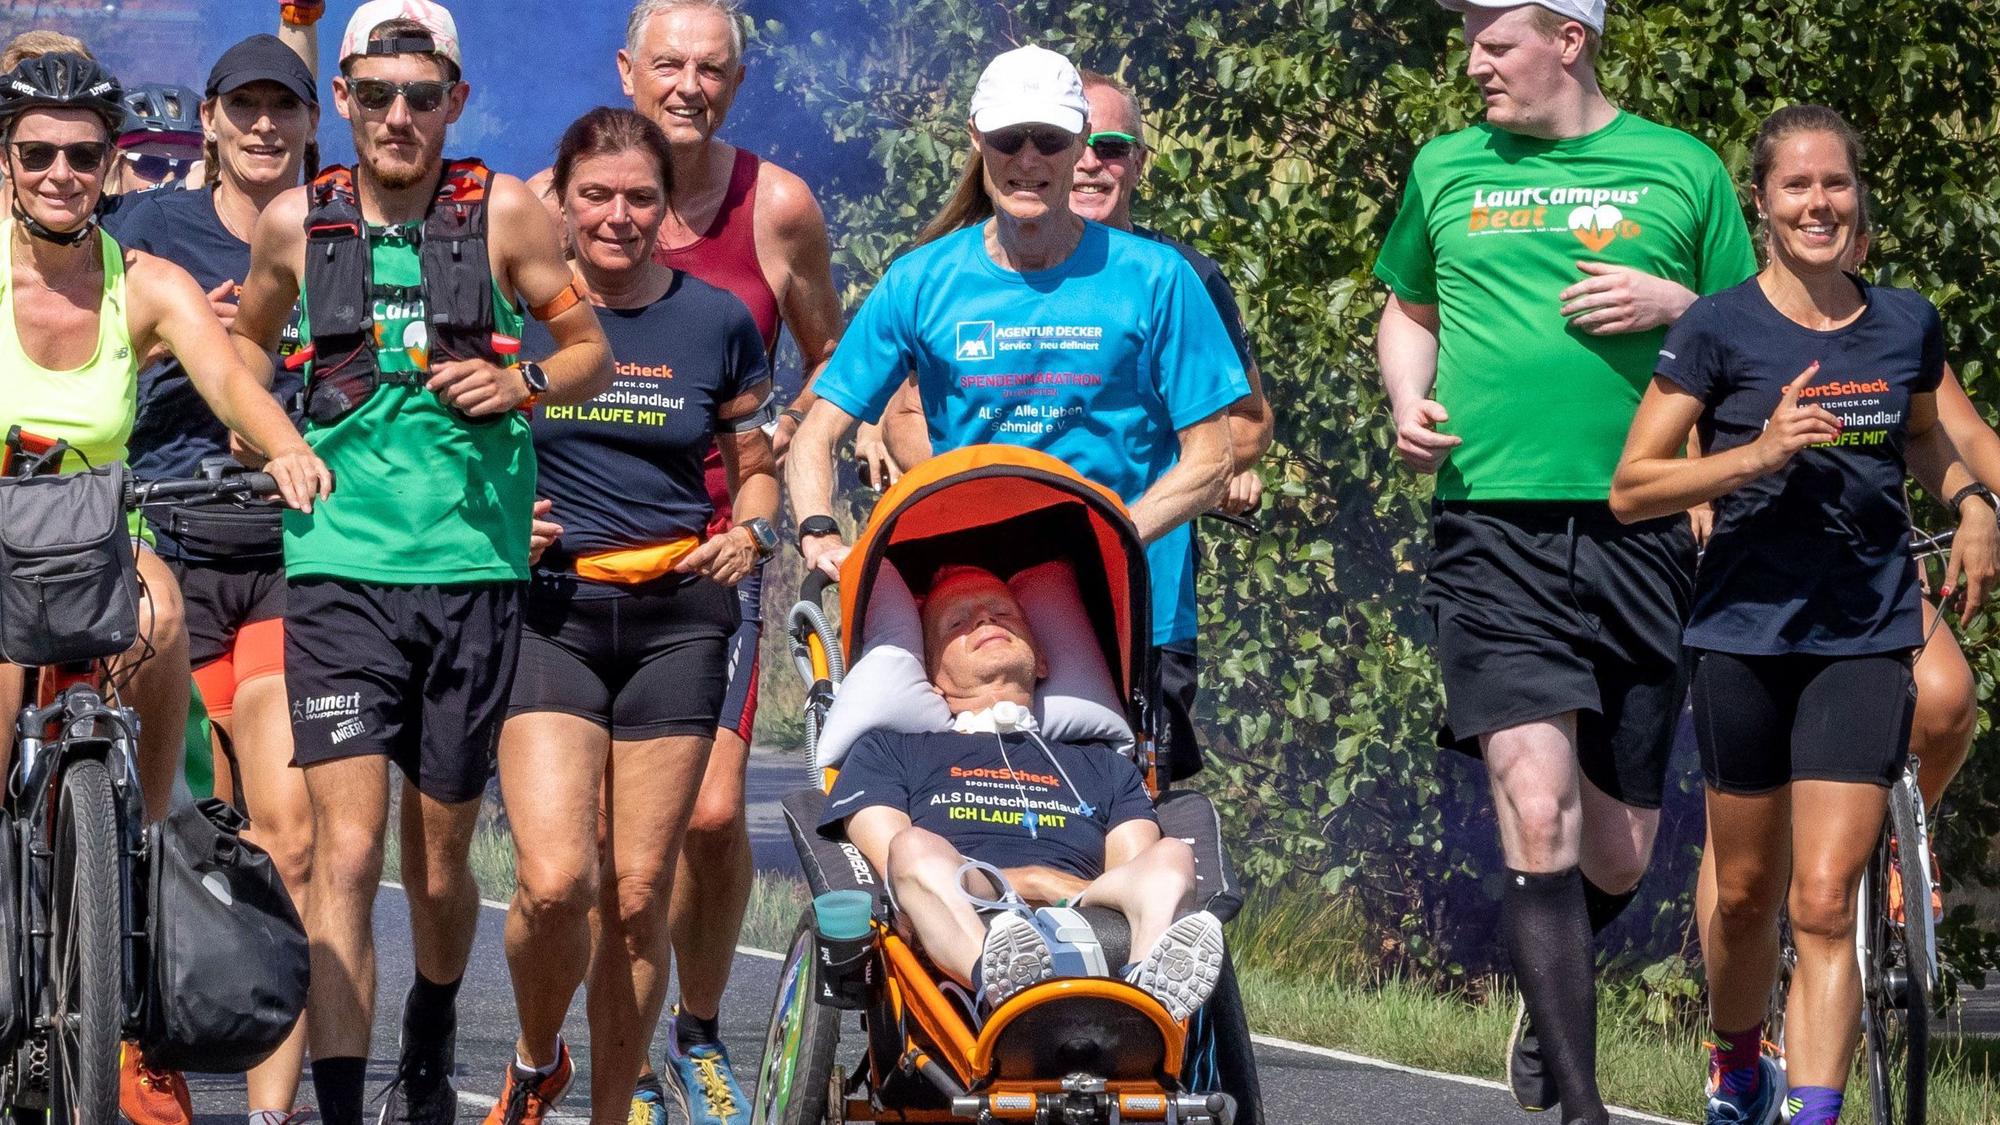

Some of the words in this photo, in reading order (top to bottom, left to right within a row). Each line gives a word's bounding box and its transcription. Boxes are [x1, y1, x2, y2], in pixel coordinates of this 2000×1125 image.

[11, 80, 37, 96] uvex
[89, 82, 113, 96] uvex
[996, 326, 1054, 338] AGENTUR
[1056, 326, 1103, 338] DECKER
[999, 341, 1032, 351] Service
[1040, 342, 1058, 350] neu
[1059, 341, 1099, 351] definiert
[614, 361, 673, 379] Scheck
[613, 381, 659, 390] HECK.COM
[960, 371, 1102, 388] SPENDENMARATHON
[594, 391, 685, 410] schlandlauf
[545, 405, 573, 419] ICH
[577, 406, 634, 423] LAUFE
[637, 410, 667, 426] MIT
[978, 406, 1002, 420] ALS
[1015, 404, 1039, 417] Alle
[1042, 405, 1083, 419] Lieben
[991, 420, 1043, 434] Schmidt
[1862, 430, 1888, 445] MIT
[306, 691, 361, 714] bunert
[305, 708, 359, 720] Wuppertal
[330, 720, 366, 744] ANGER!
[950, 766, 1060, 787] SportScheck
[965, 780, 1048, 792] SPORTSCHECK.COM
[930, 792, 962, 806] ALS
[949, 806, 978, 820] ICH
[981, 808, 1025, 825] LAUF
[1038, 814, 1066, 828] MIT
